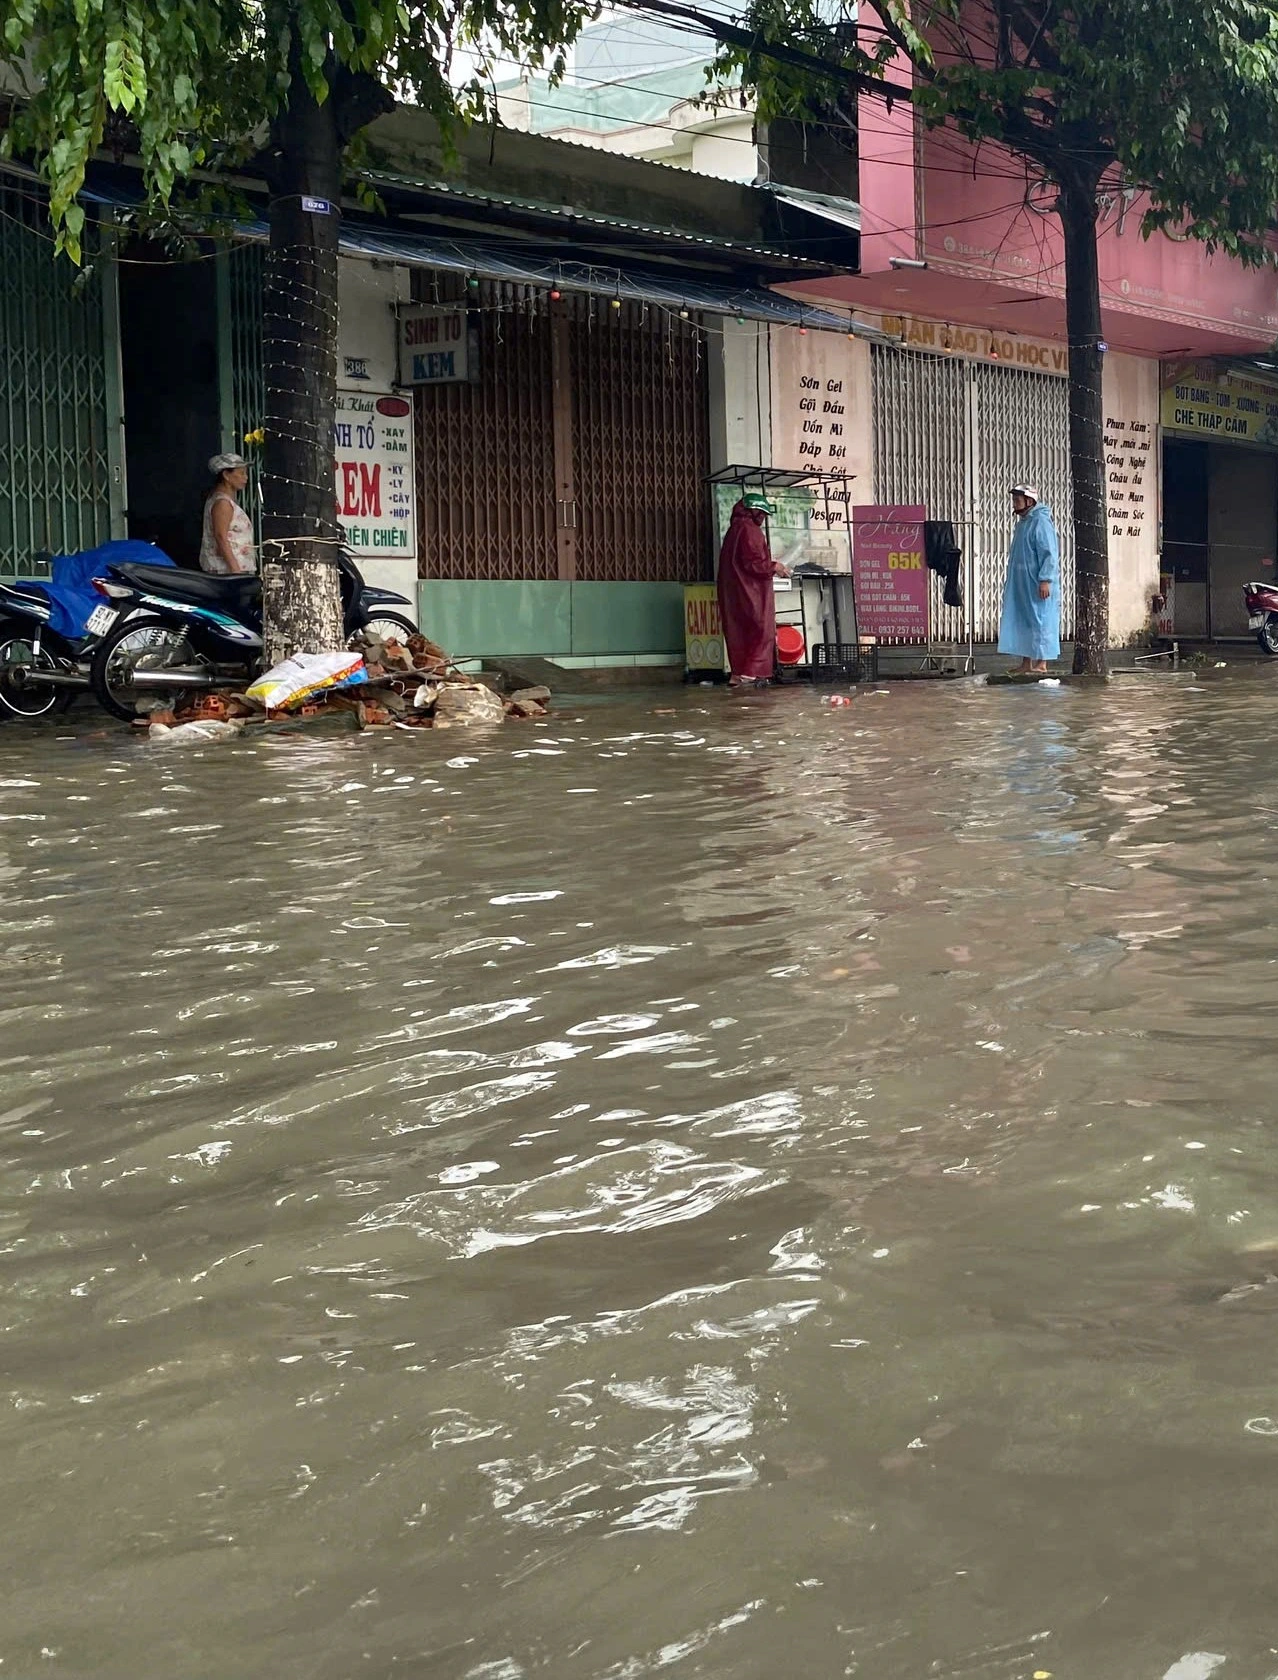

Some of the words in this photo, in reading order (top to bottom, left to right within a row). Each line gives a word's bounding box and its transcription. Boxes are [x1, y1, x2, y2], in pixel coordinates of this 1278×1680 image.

[405, 317, 438, 345] SINH
[413, 351, 455, 379] KEM
[827, 379, 842, 393] Gel
[335, 423, 352, 448] NH
[386, 427, 405, 437] XAY
[393, 480, 403, 488] LY
[346, 525, 369, 546] IÊN
[373, 526, 407, 547] CHIÊN
[1113, 525, 1122, 535] Da
[888, 552, 921, 569] 65K
[688, 600, 707, 635] CAM
